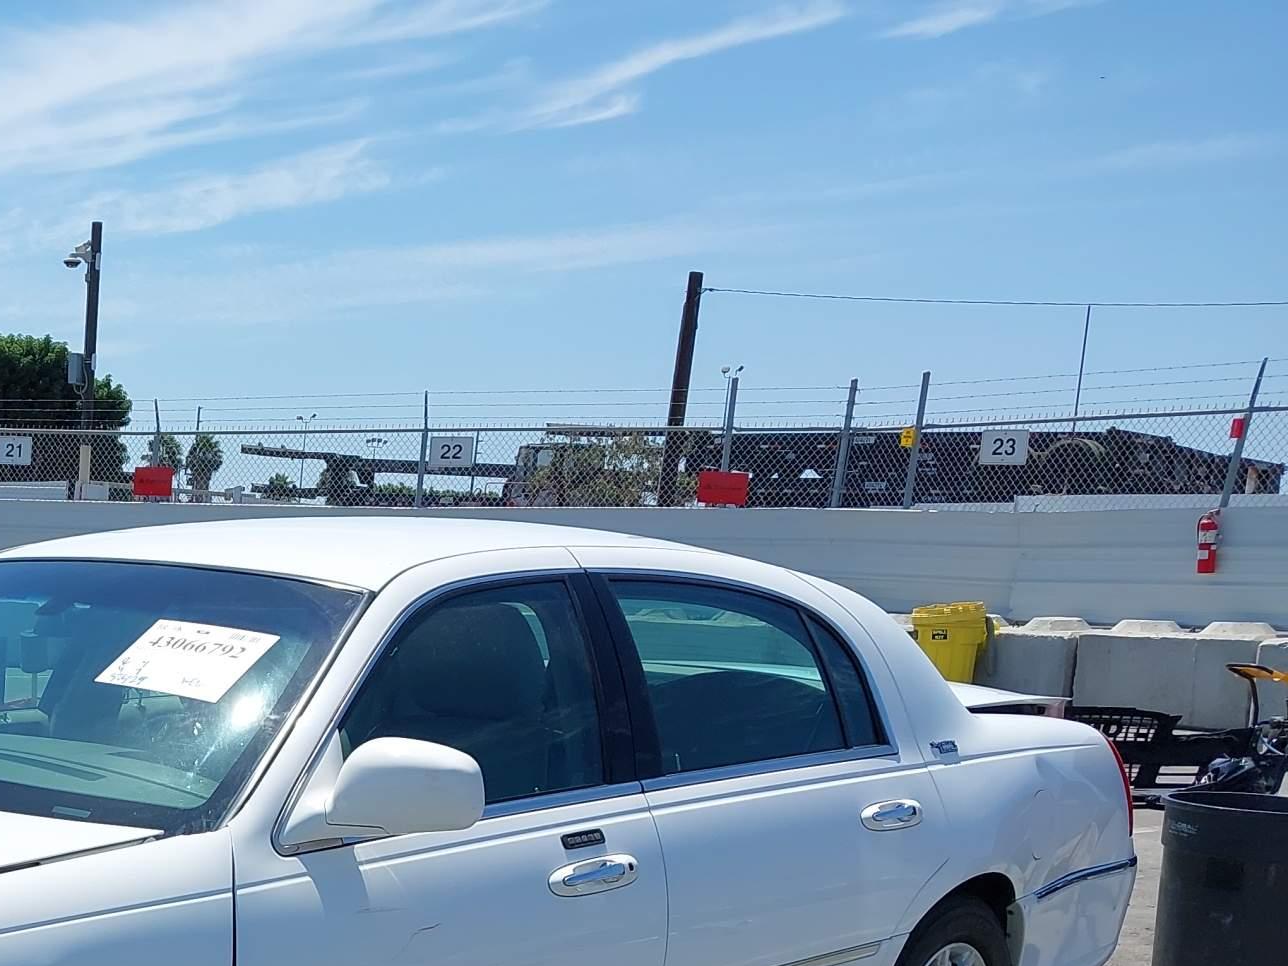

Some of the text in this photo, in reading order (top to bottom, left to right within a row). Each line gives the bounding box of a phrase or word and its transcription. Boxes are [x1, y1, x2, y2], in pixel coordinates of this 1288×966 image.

[4, 443, 23, 458] 21
[439, 443, 464, 460] 22
[991, 438, 1017, 457] 23
[147, 635, 247, 659] 43066792
